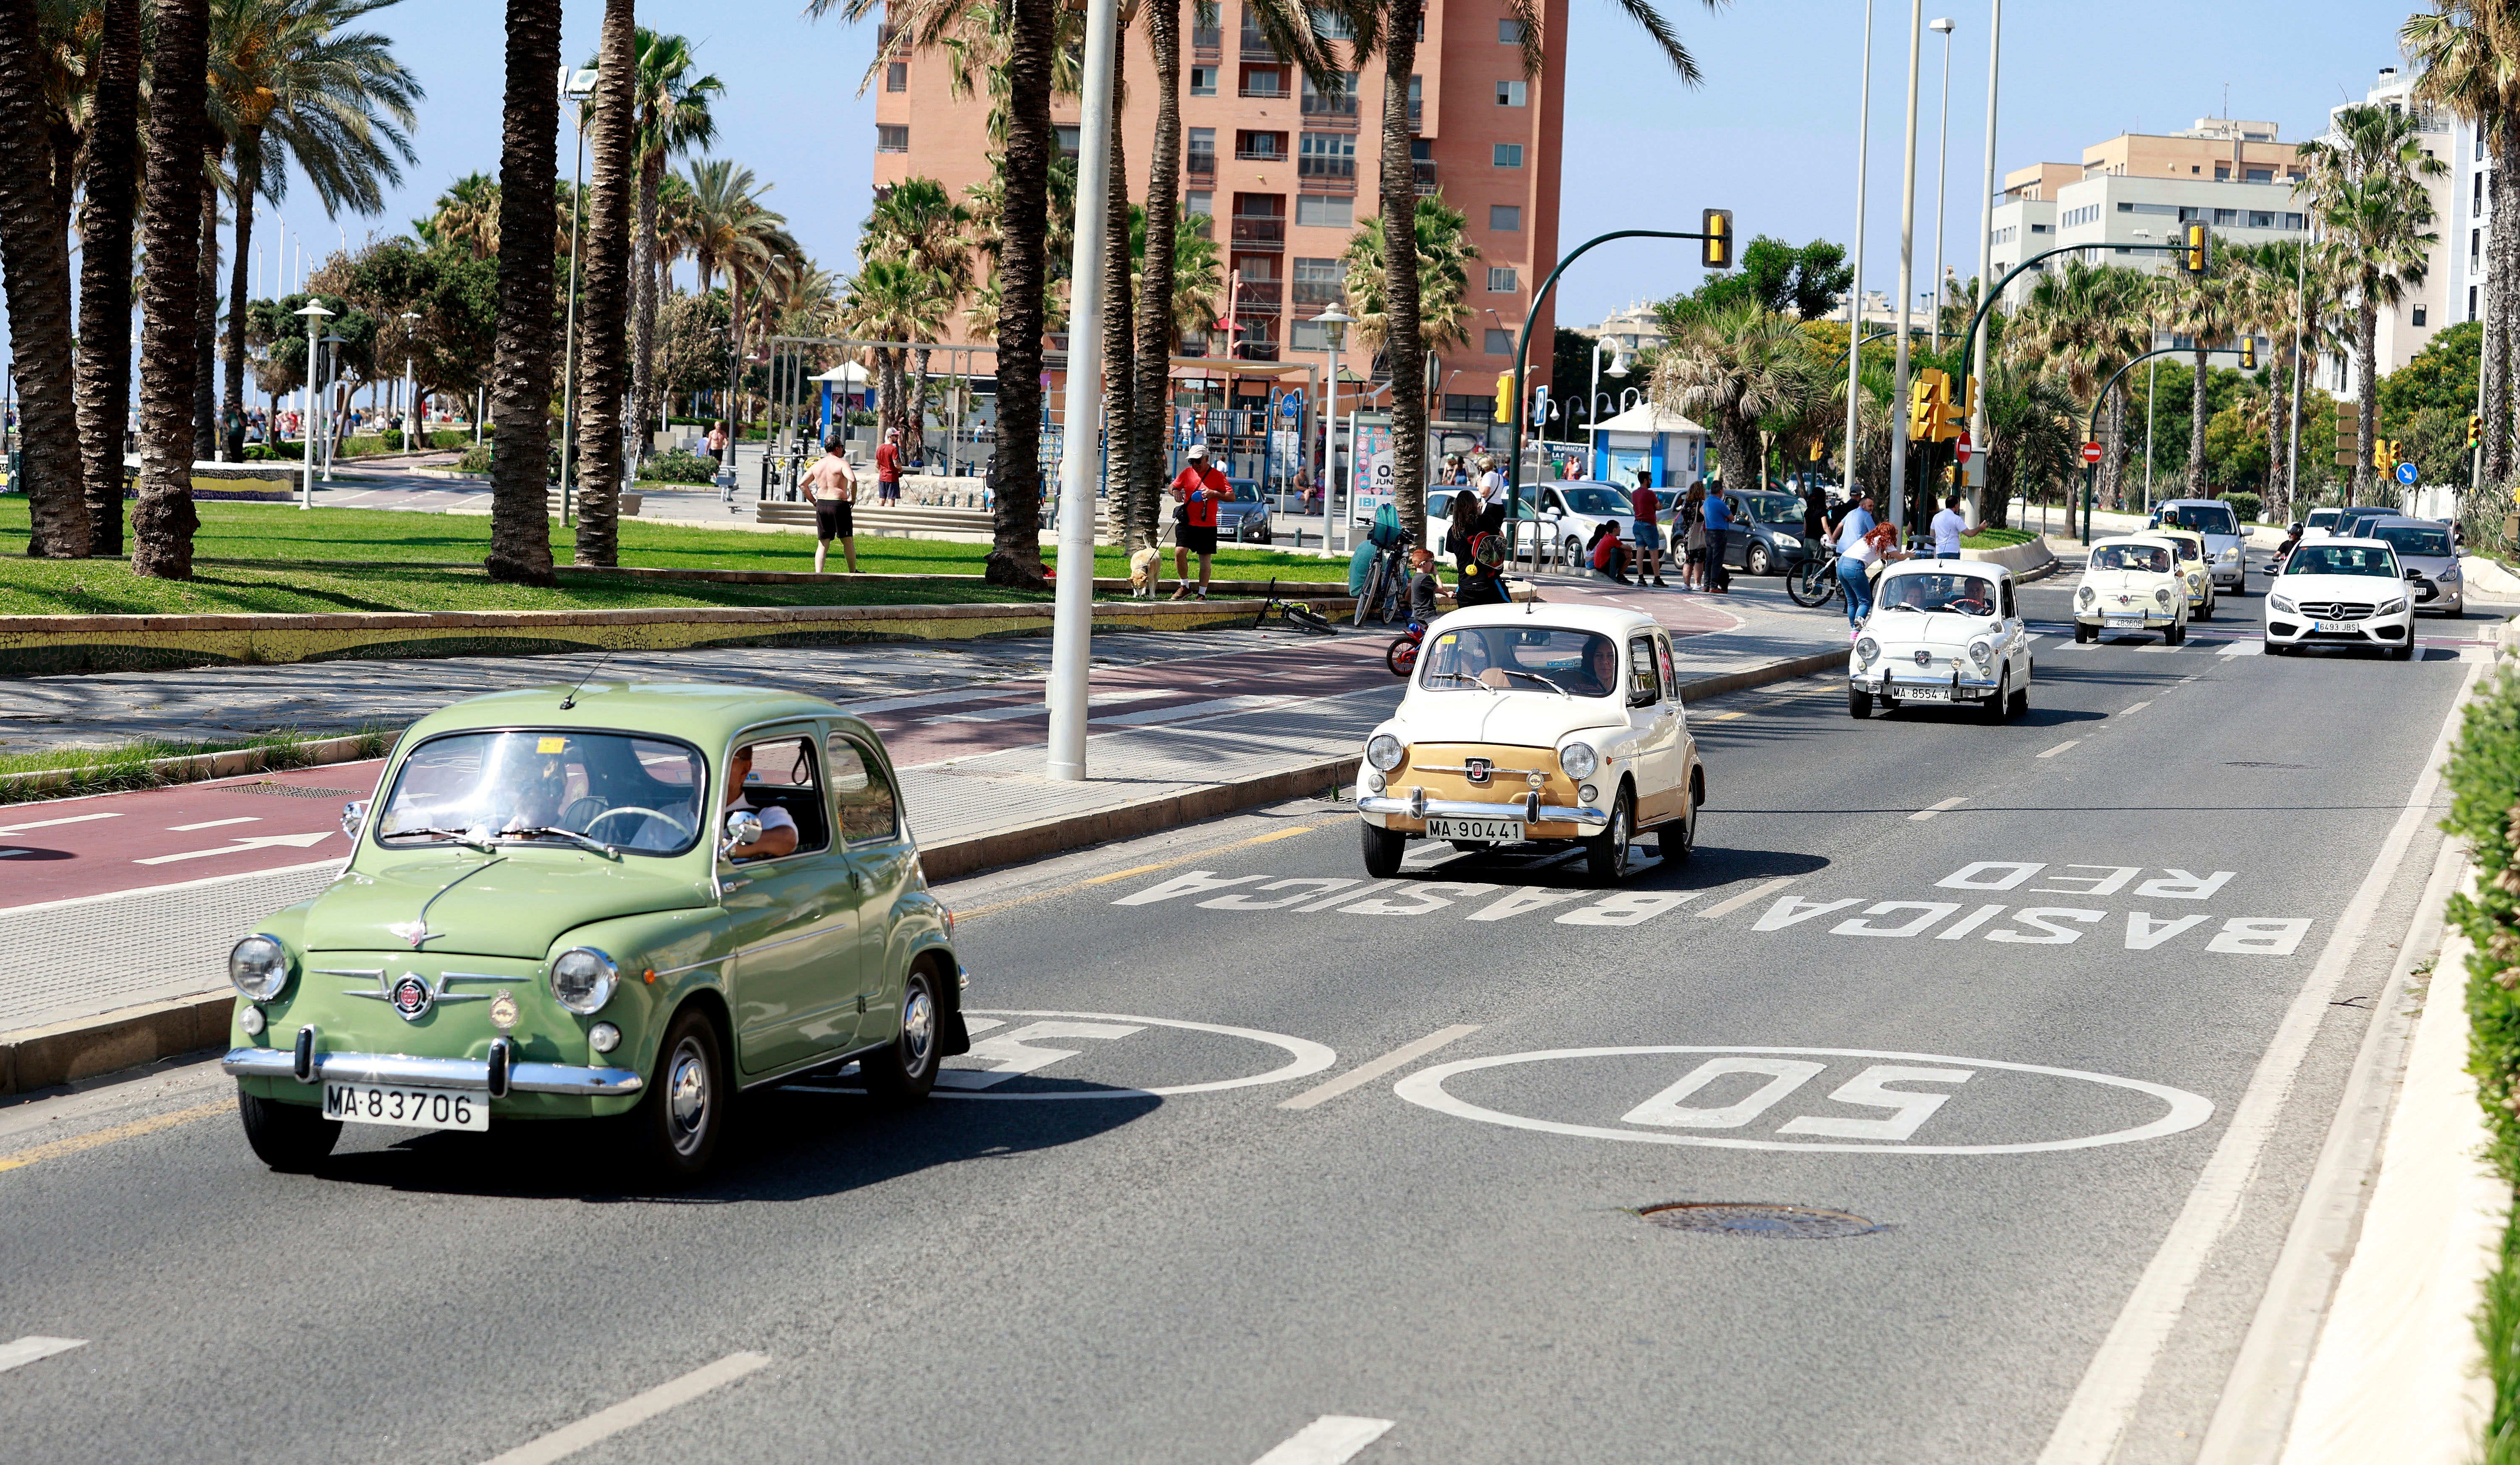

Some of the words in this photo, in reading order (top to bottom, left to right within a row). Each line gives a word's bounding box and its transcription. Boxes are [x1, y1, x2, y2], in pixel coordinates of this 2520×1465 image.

[1378, 464, 1394, 477] 0
[1359, 497, 1376, 507] IBI
[1111, 870, 1706, 926] BASICA
[1933, 861, 2237, 900] RED
[1750, 895, 2315, 956] BASICA
[933, 1017, 1148, 1090] 5
[1620, 1057, 1977, 1140] 50
